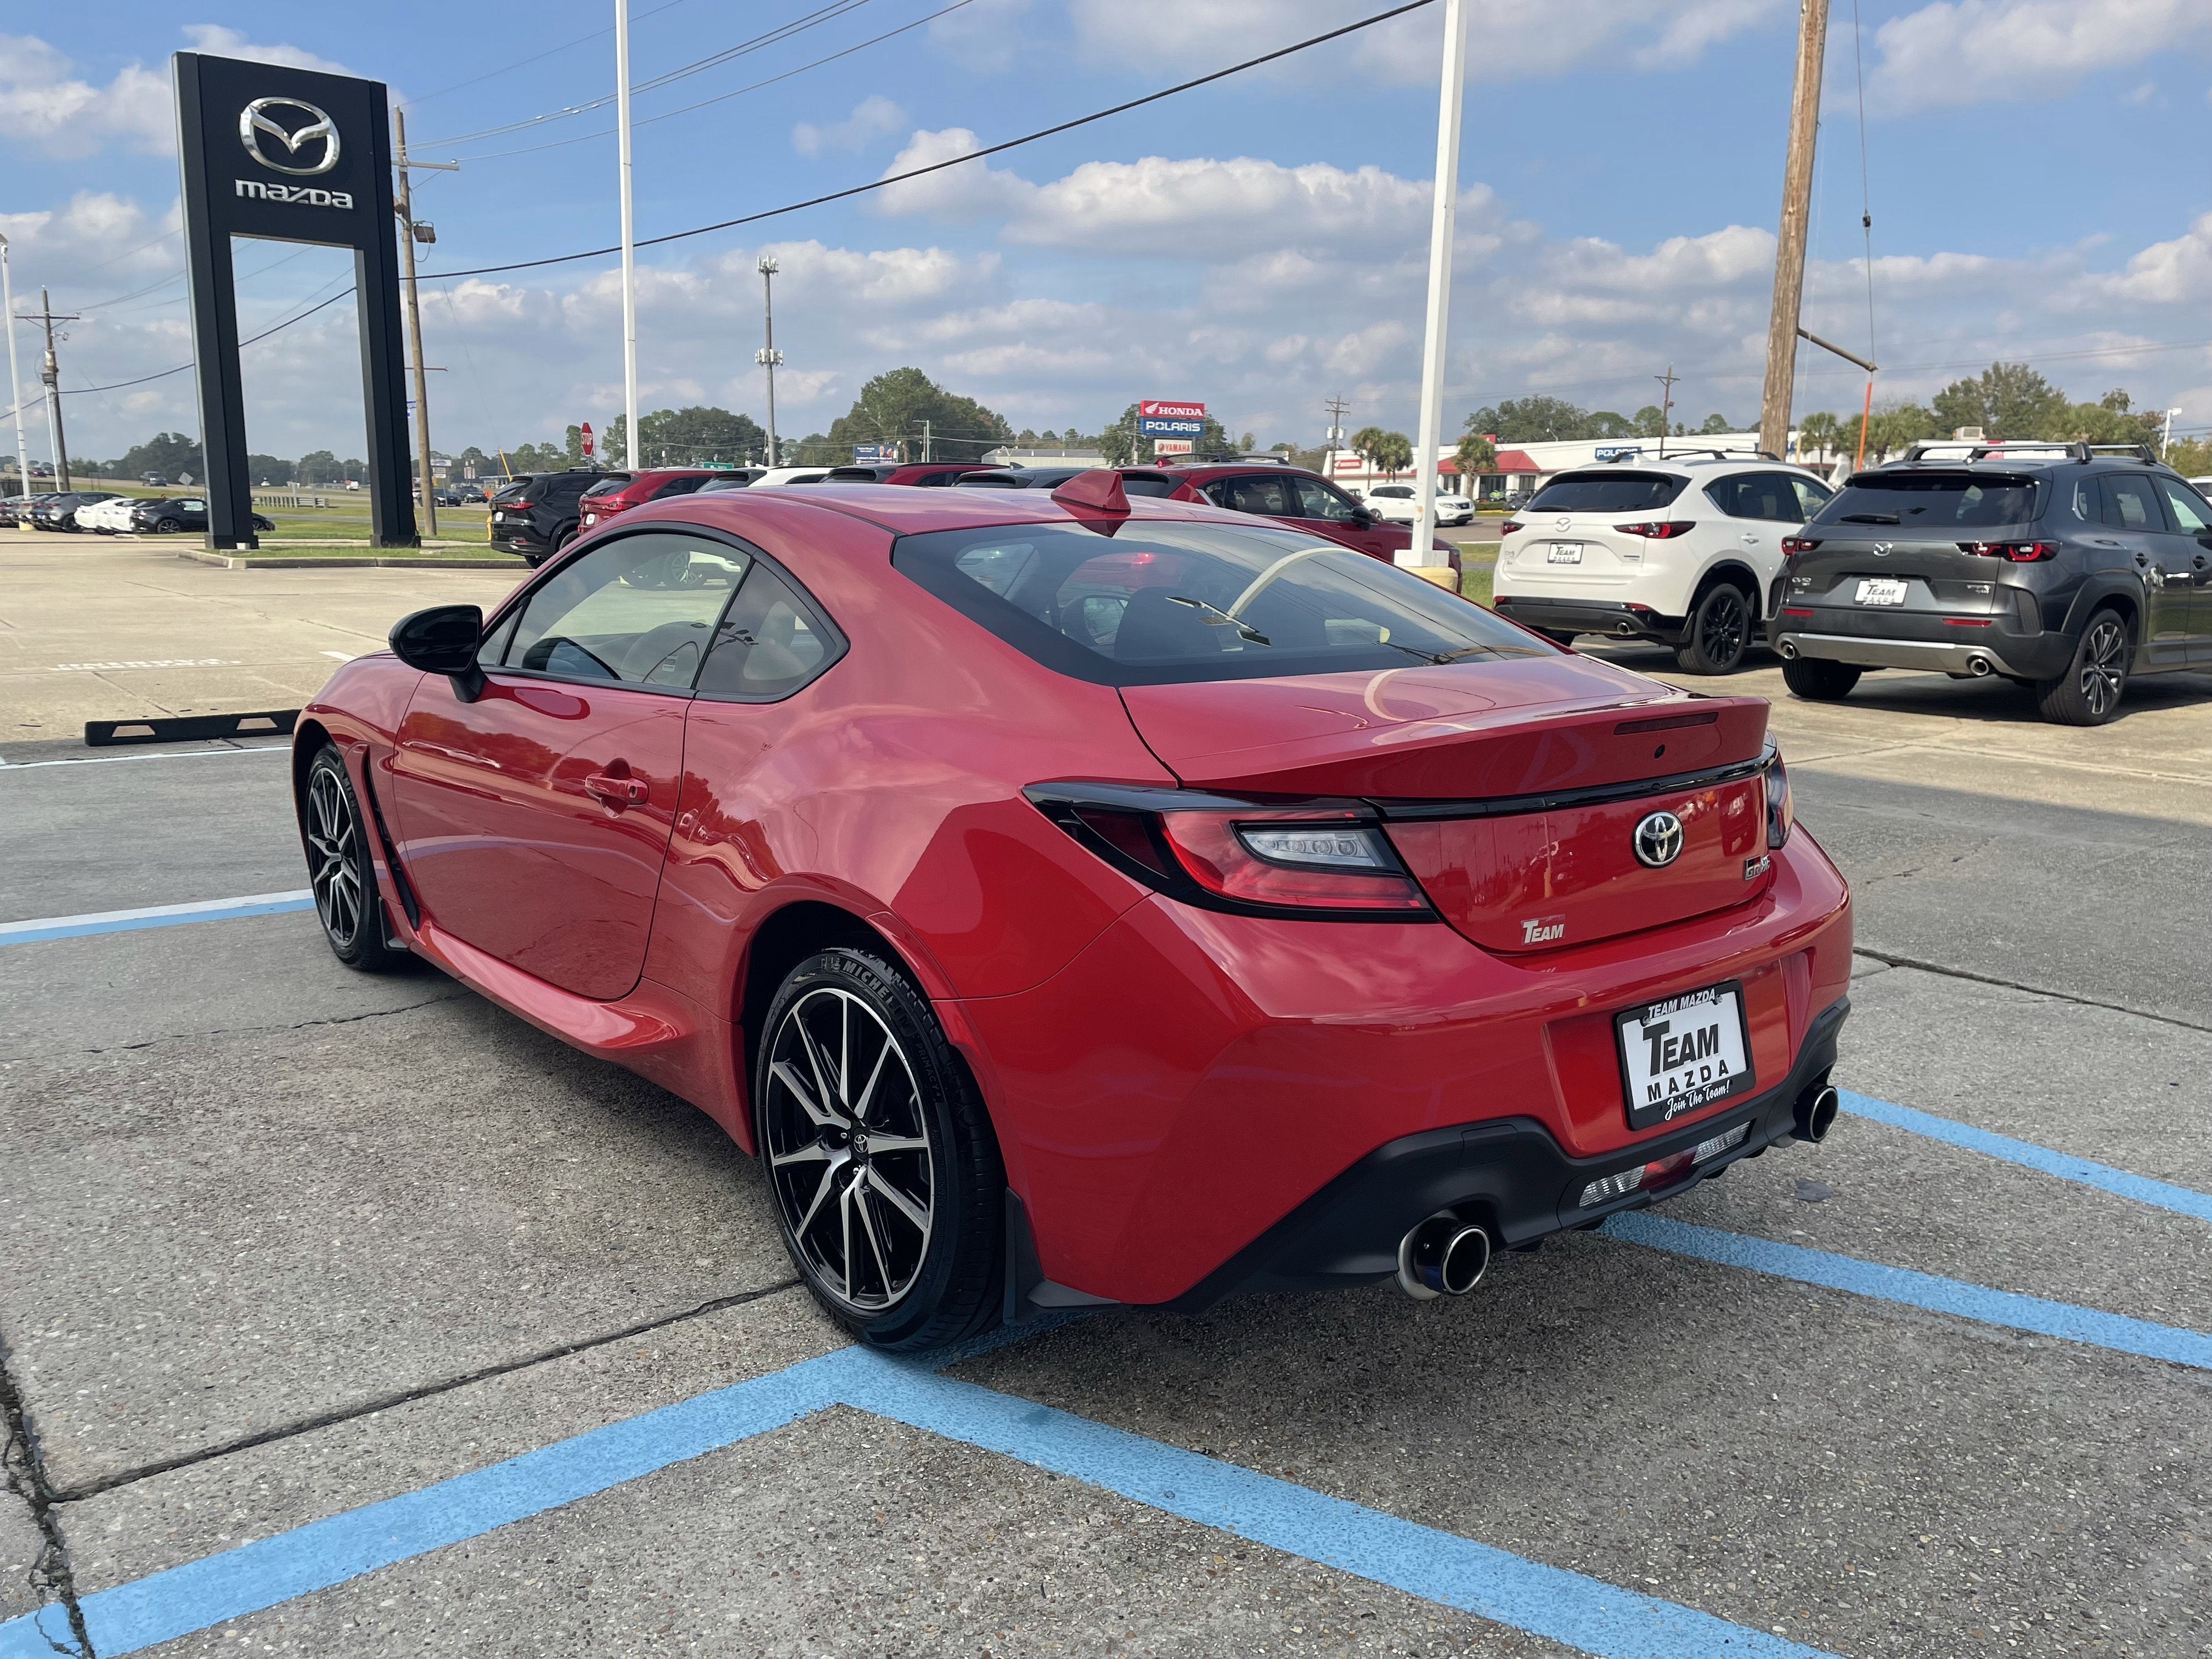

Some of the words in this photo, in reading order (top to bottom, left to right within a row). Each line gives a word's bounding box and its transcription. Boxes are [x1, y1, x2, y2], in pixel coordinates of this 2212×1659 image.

[235, 179, 353, 210] mazda
[1158, 407, 1204, 416] HONDA
[1146, 421, 1201, 432] POLARIS
[582, 432, 592, 445] STOP
[1165, 444, 1190, 452] YAMAHA
[1556, 546, 1576, 555] TEAM
[1866, 584, 1896, 596] TEAM
[1523, 920, 1564, 944] TEAM
[1648, 1001, 1677, 1019] TEAM
[1680, 988, 1716, 1009] MAZDA
[1643, 1020, 1719, 1076] TEAM
[1646, 1059, 1729, 1102] MAZDA
[1664, 1097, 1686, 1121] Join
[1686, 1089, 1704, 1108] The
[1703, 1079, 1730, 1102] Team!
